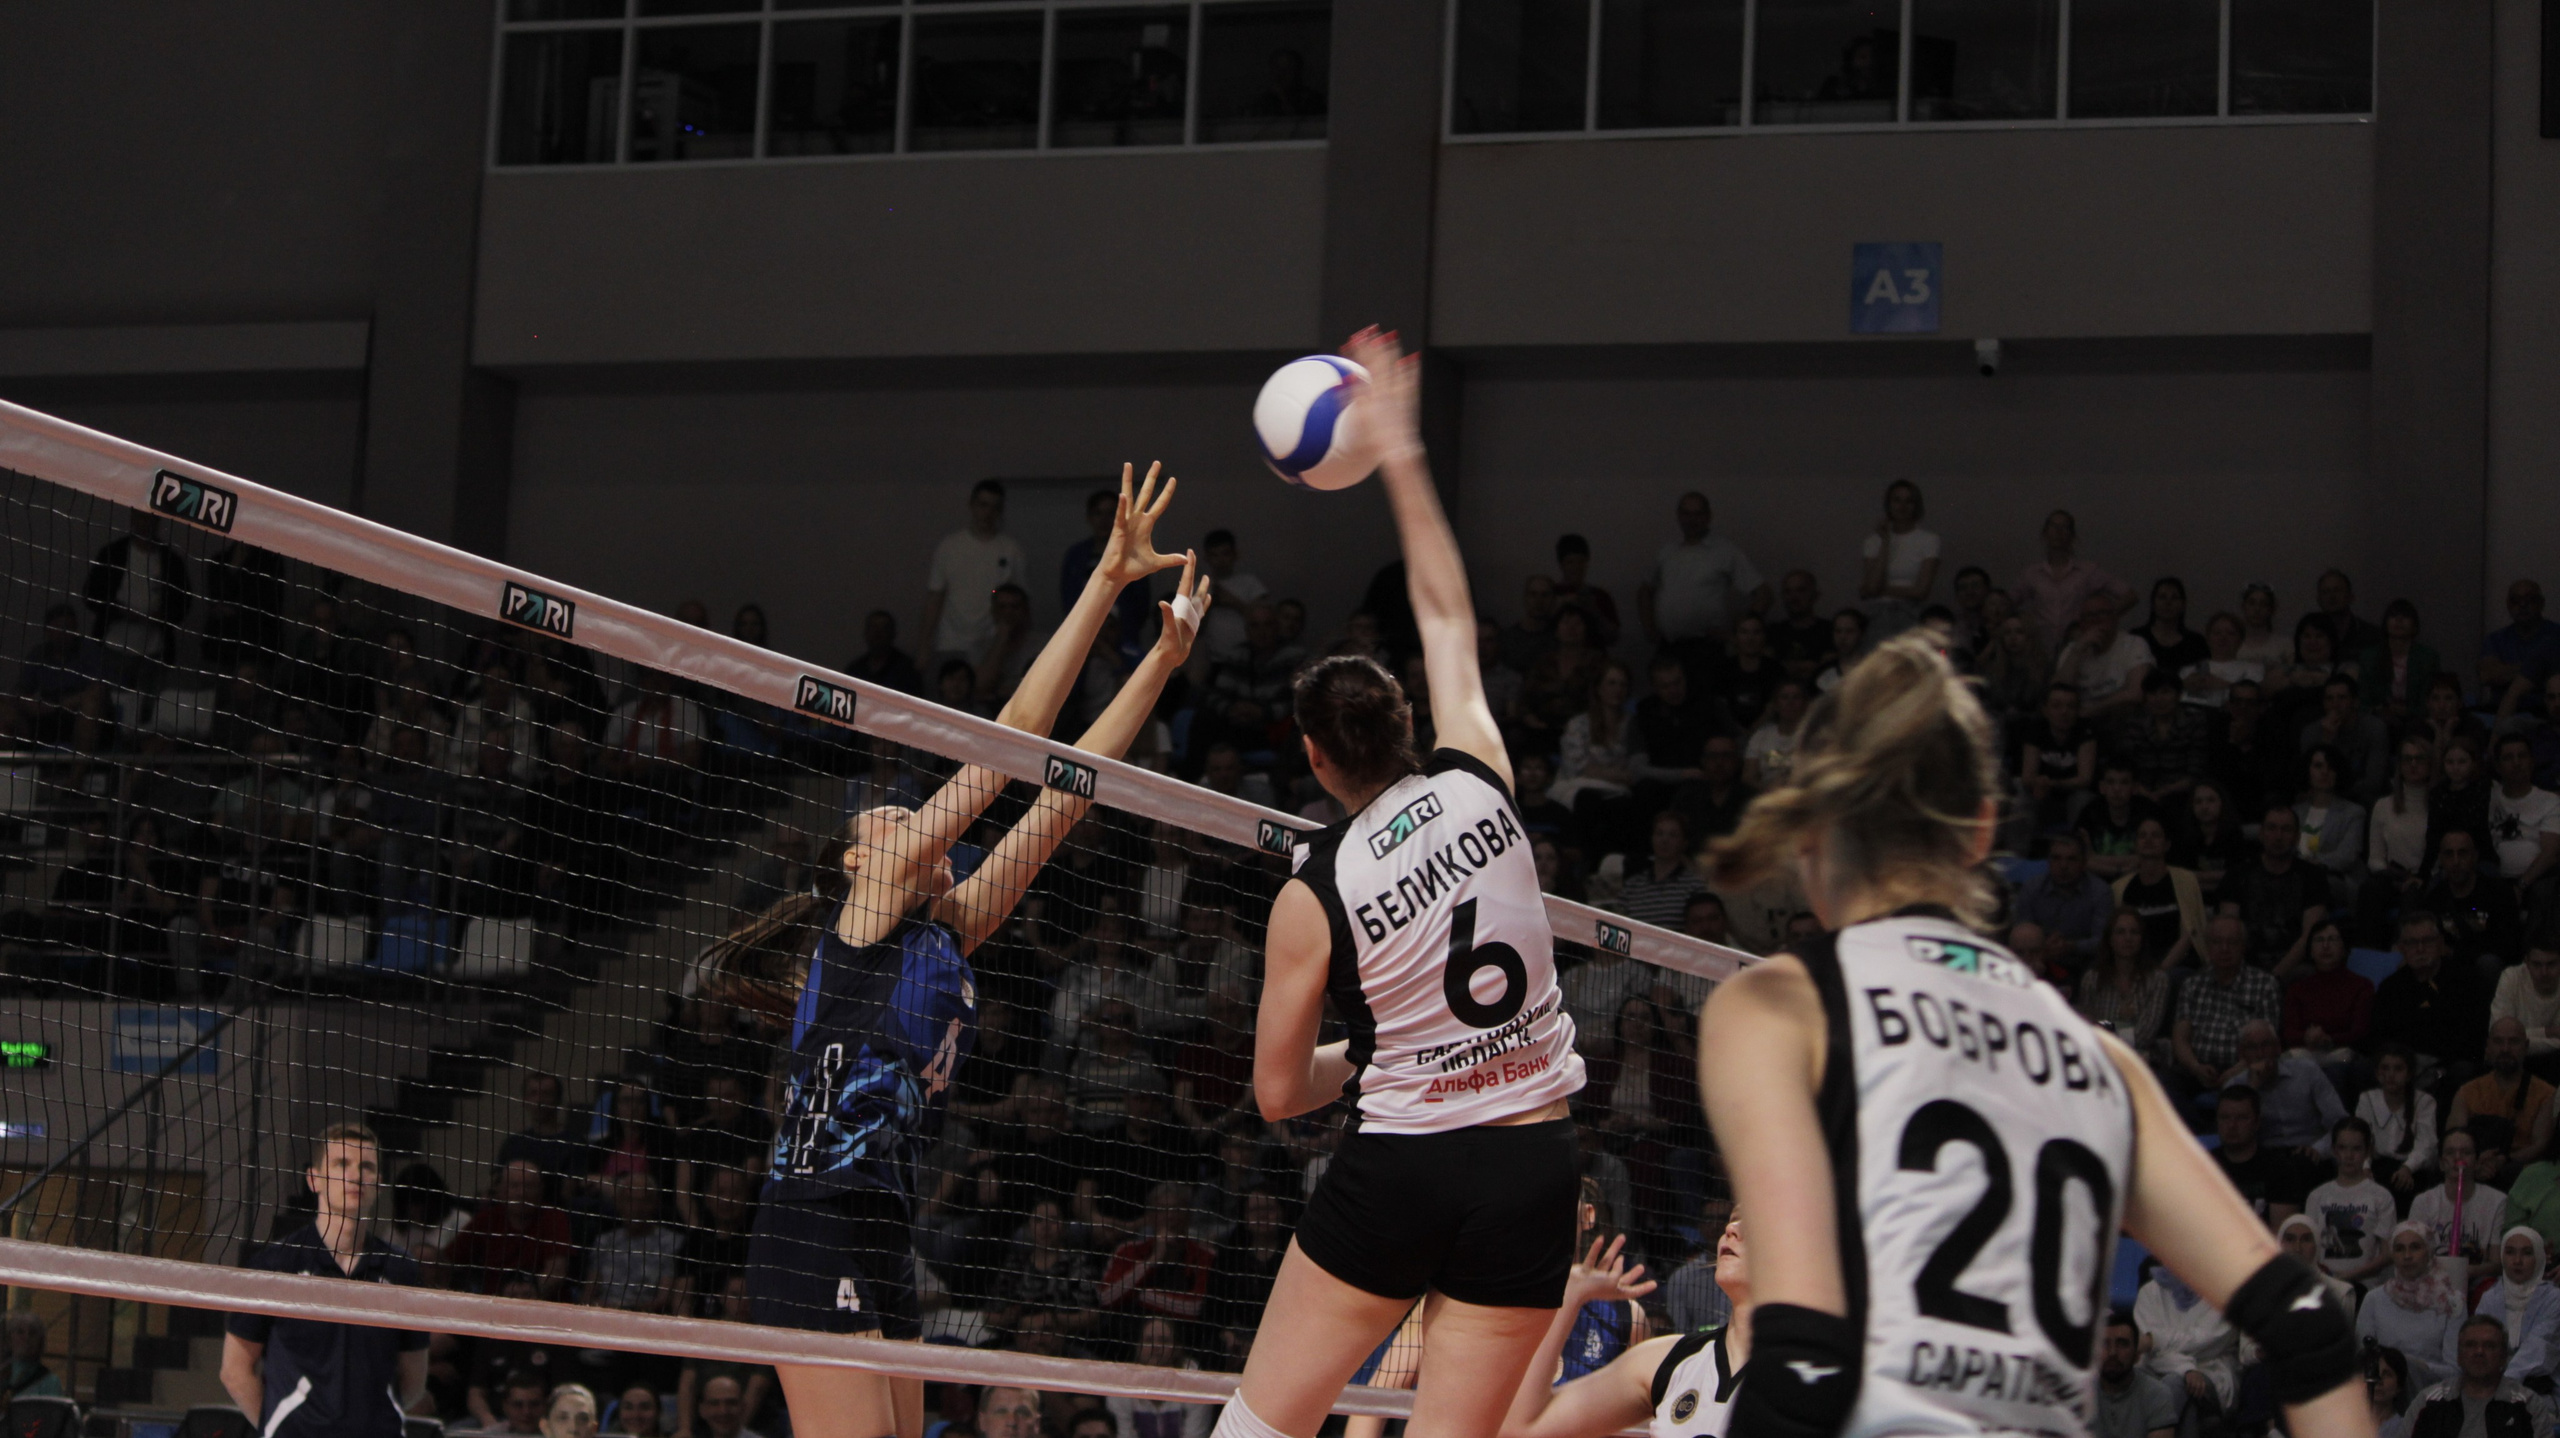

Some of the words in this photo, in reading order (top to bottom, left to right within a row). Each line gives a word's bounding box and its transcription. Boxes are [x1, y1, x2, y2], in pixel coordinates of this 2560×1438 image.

[156, 475, 231, 527] PARI
[506, 588, 569, 633] PARI
[800, 680, 851, 719] PARI
[1047, 759, 1092, 795] PARI
[1370, 794, 1442, 858] PARI
[1355, 808, 1521, 944] БЕЛИКОВА
[1444, 896, 1527, 1028] 6
[1600, 925, 1630, 953] PARI
[1425, 1069, 1499, 1102] Альфа
[1503, 1053, 1549, 1083] Банк
[1898, 1100, 2113, 1370] 20
